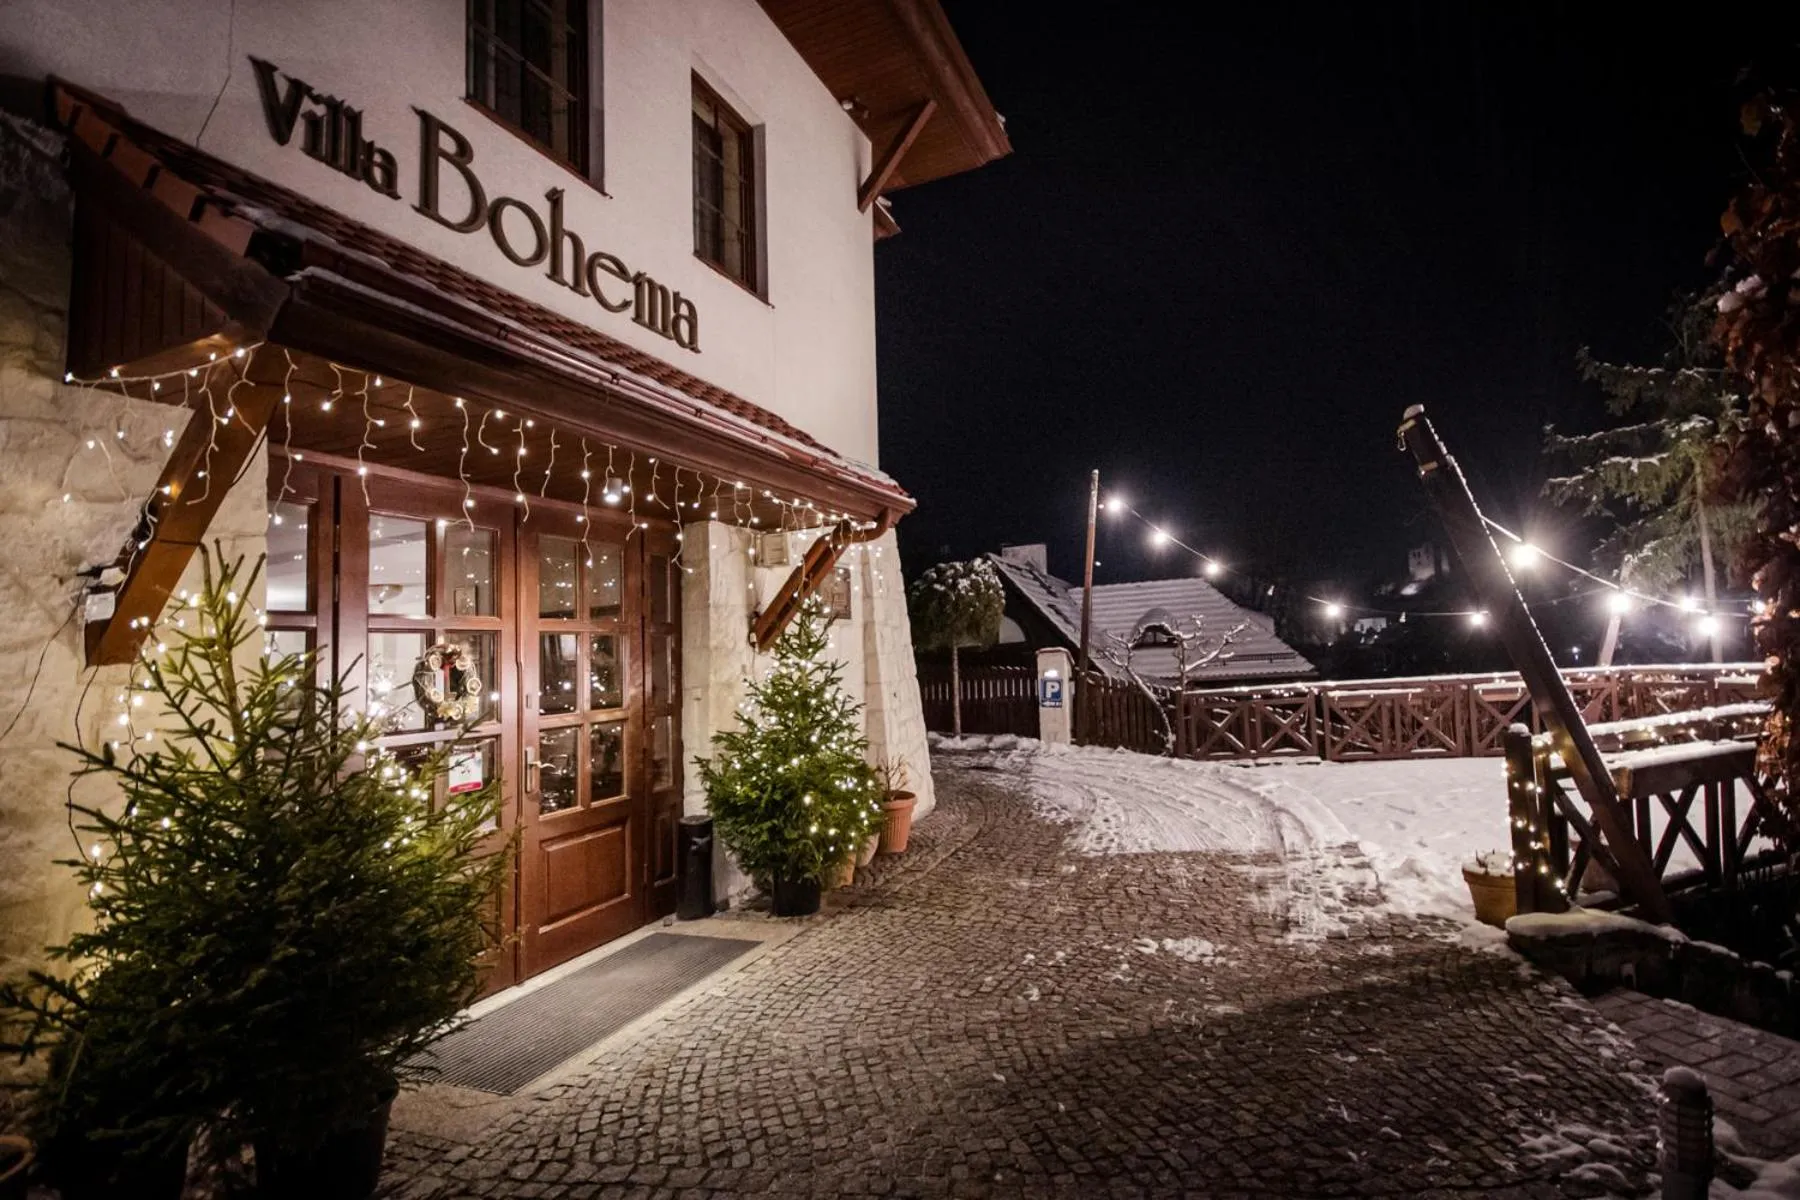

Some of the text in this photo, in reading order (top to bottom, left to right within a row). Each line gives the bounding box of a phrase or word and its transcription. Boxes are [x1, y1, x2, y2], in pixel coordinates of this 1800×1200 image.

[247, 55, 702, 354] Villa Bohema
[1045, 681, 1060, 698] P
